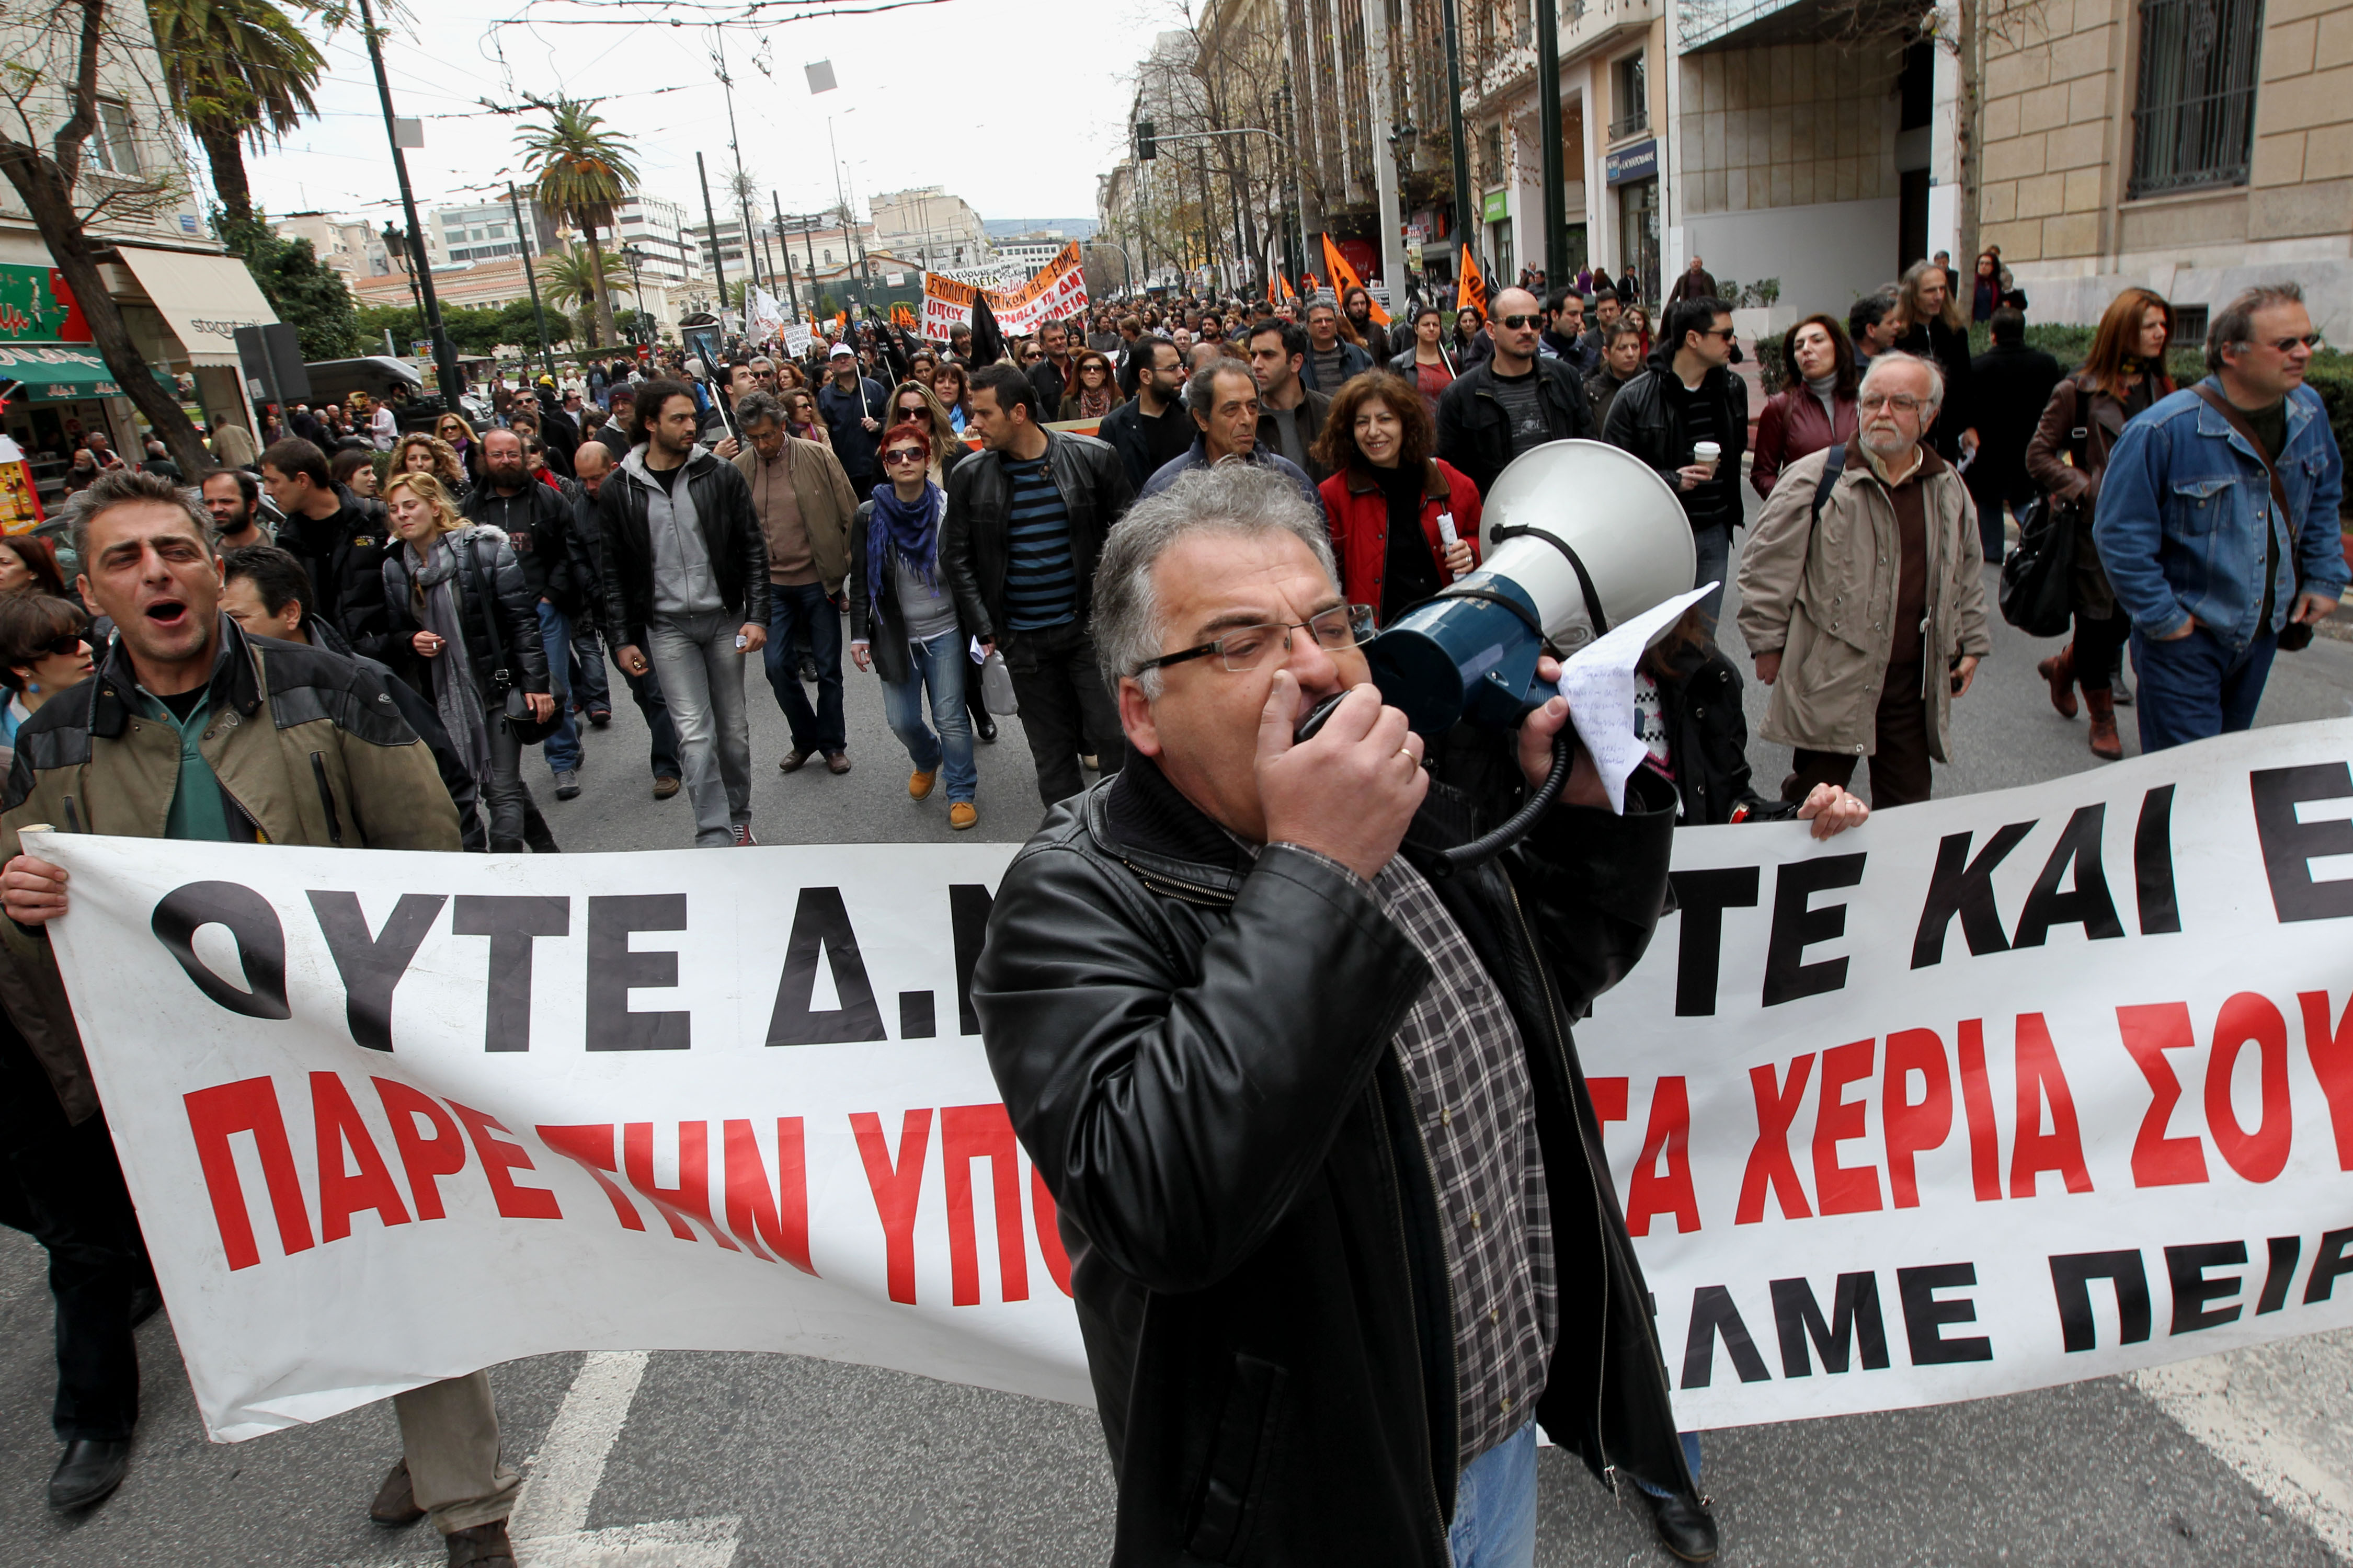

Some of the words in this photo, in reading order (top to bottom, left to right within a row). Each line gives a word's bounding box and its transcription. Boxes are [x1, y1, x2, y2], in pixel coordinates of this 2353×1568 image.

[927, 299, 965, 321] ΟΠΟΥ
[994, 304, 1037, 324] ΡΝΑΕΙ
[957, 276, 1000, 287] ΙΔΕΙΑ
[151, 880, 691, 1053] ΟΥΤΕ
[1584, 851, 1867, 1017] ΤΕ
[1910, 783, 2182, 970] ΚΑΙ
[182, 1070, 563, 1271] ΠΑΡΕ
[534, 1116, 823, 1279] ΤΗΝ
[1734, 1012, 2095, 1226] ΧΕΡΙΑ
[2115, 988, 2353, 1189] ΣΟΥ
[1649, 1262, 1993, 1391] ΛΜΕ
